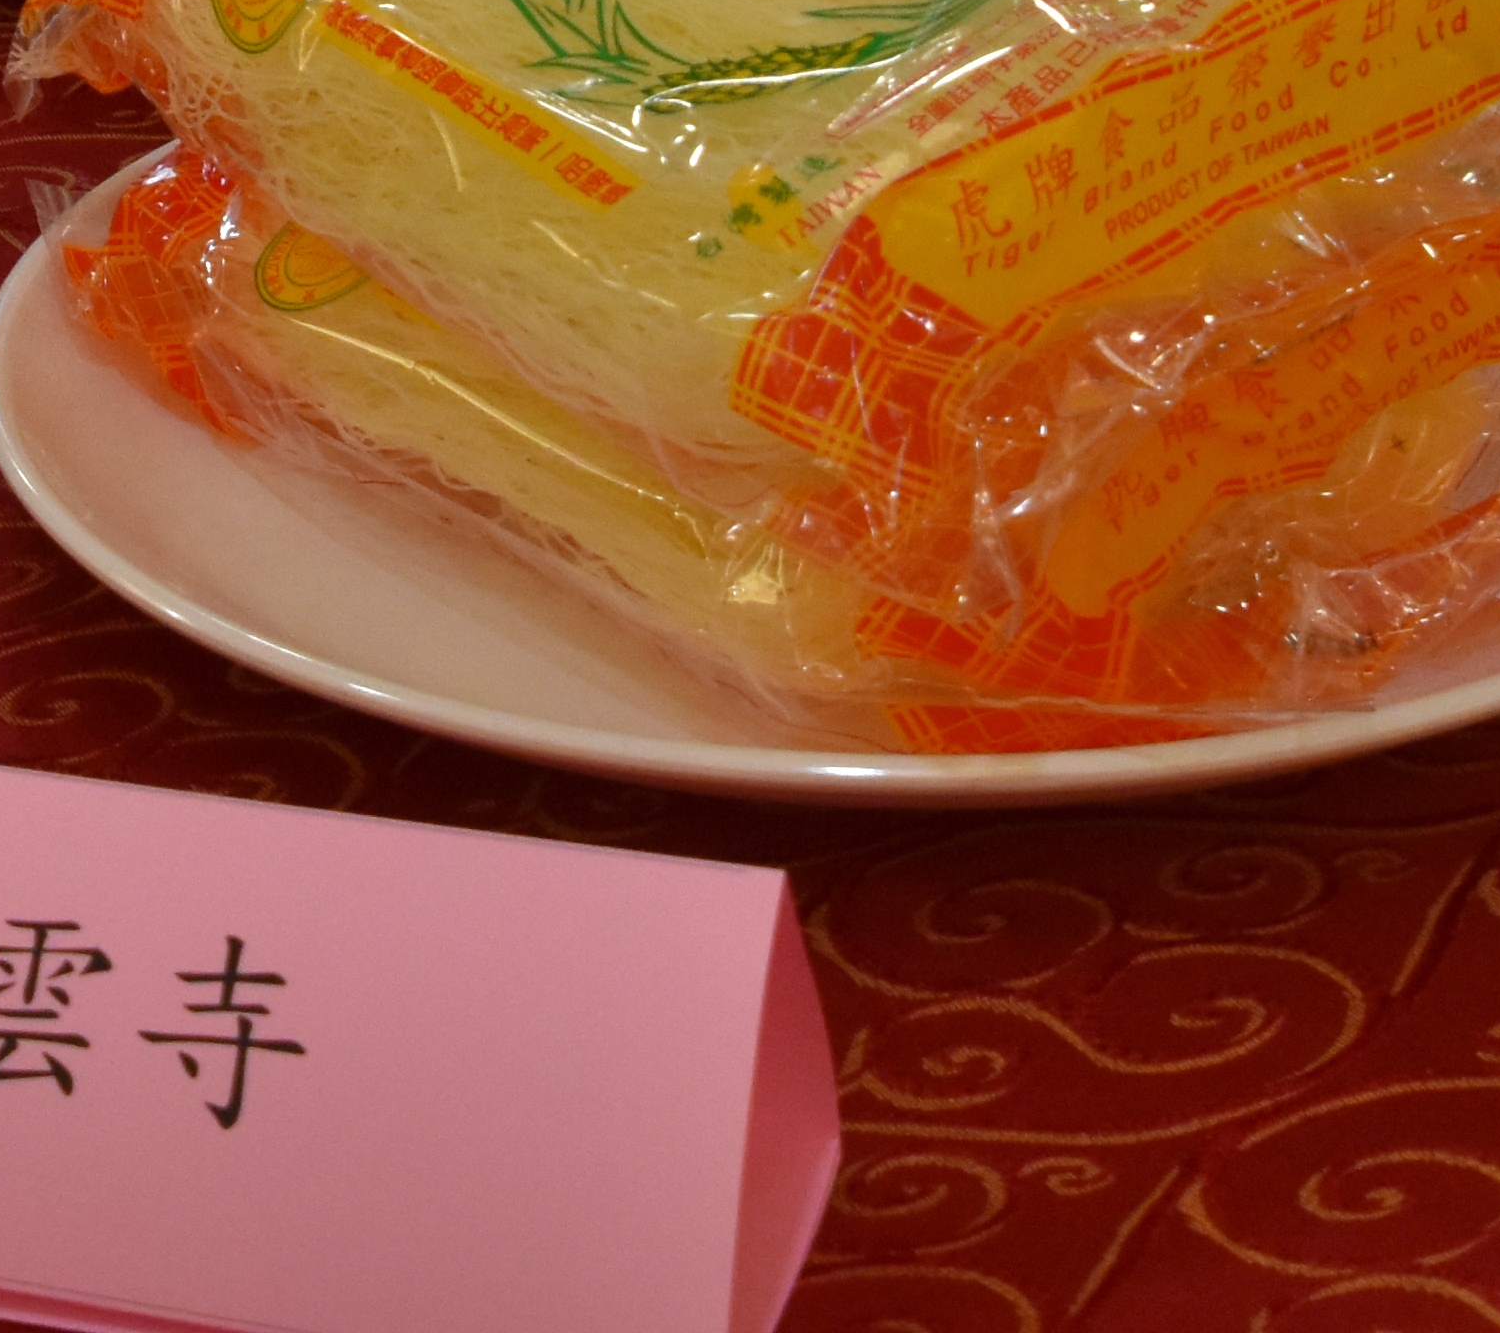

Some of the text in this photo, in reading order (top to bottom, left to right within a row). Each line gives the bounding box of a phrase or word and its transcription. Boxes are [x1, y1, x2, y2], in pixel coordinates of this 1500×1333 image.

[775, 161, 886, 251] TAIWAN
[961, 217, 1059, 281] Tiger
[1082, 143, 1181, 217] Brand
[1207, 82, 1298, 146] Food
[1415, 6, 1472, 53] Ltd
[1103, 112, 1333, 243] PRODUCT OF TAIWAN
